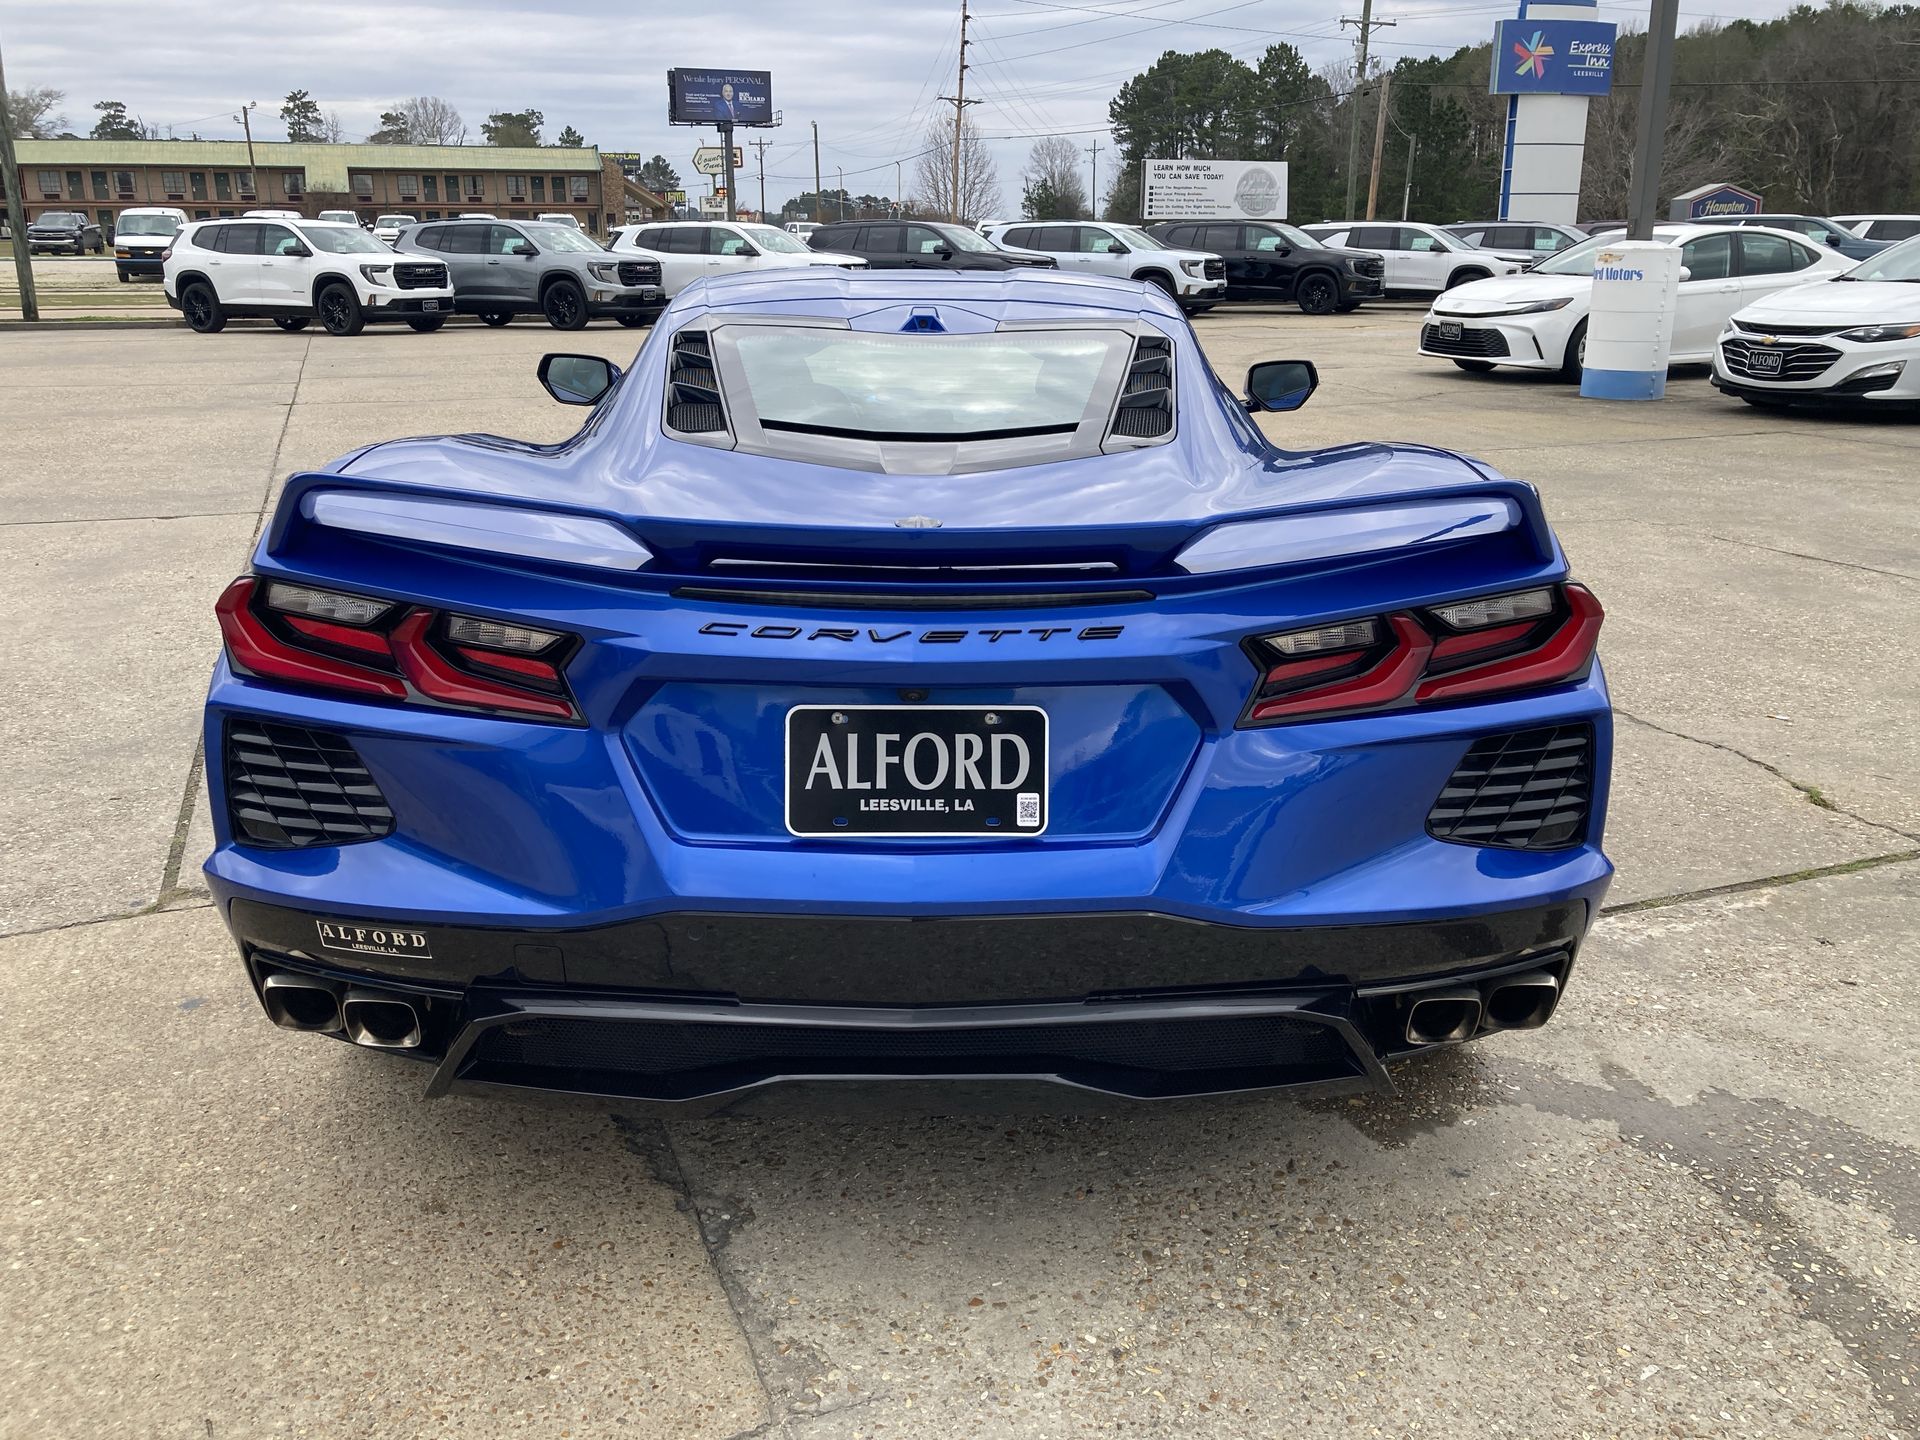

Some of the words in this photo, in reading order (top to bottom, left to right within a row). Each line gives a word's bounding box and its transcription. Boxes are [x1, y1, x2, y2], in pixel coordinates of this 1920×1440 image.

[1570, 40, 1611, 54] Express
[1586, 54, 1610, 66] Inn
[707, 76, 723, 84] Injury
[697, 155, 724, 166] Countr
[1700, 200, 1749, 216] Hampton
[1606, 267, 1643, 281] Motors
[1750, 354, 1779, 366] ALFORD
[698, 622, 1125, 643] CORVETTE
[804, 732, 1030, 791] ALFORD
[860, 799, 949, 813] LEESVILLE,
[954, 799, 974, 811] LA
[323, 924, 426, 948] ALFORD
